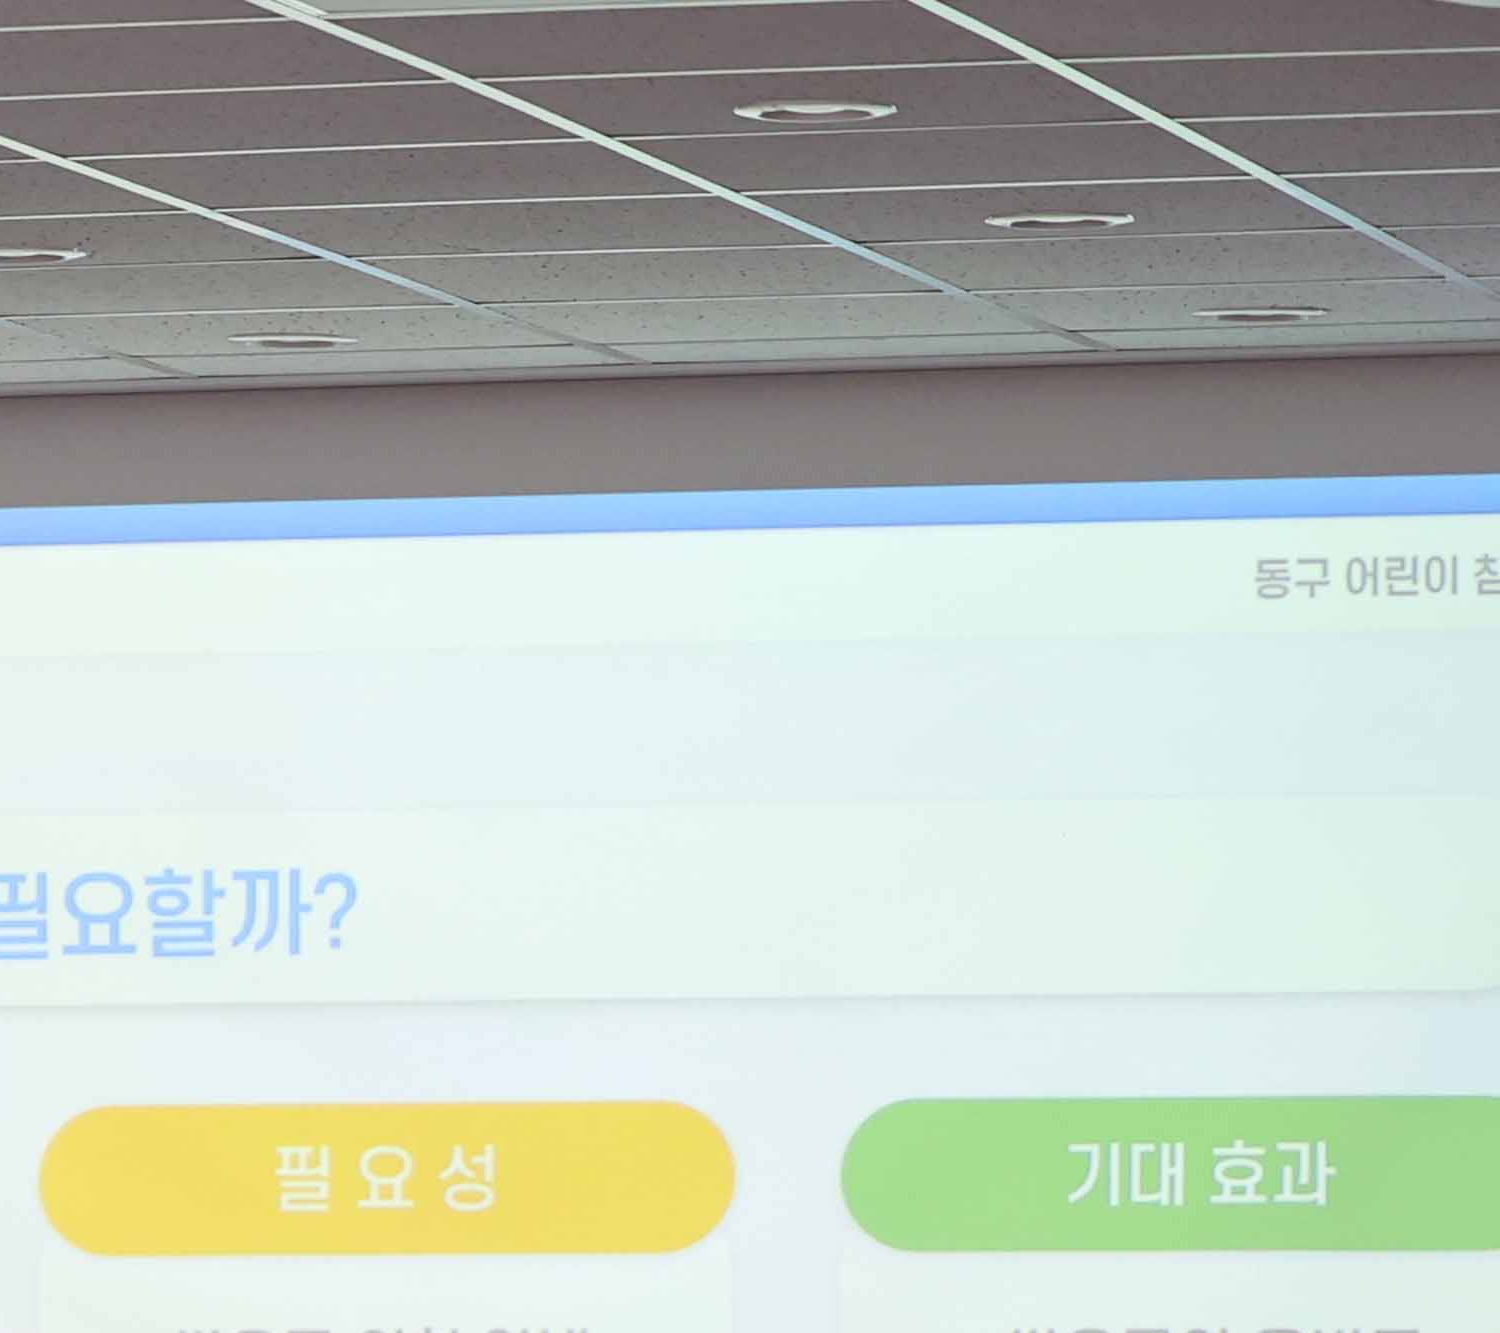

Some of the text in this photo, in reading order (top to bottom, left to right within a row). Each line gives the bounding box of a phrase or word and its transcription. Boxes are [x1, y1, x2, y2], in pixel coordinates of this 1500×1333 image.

[1254, 557, 1331, 601] 동구
[1345, 554, 1459, 597] 어린이
[1067, 1139, 1337, 1207] 기대 효과
